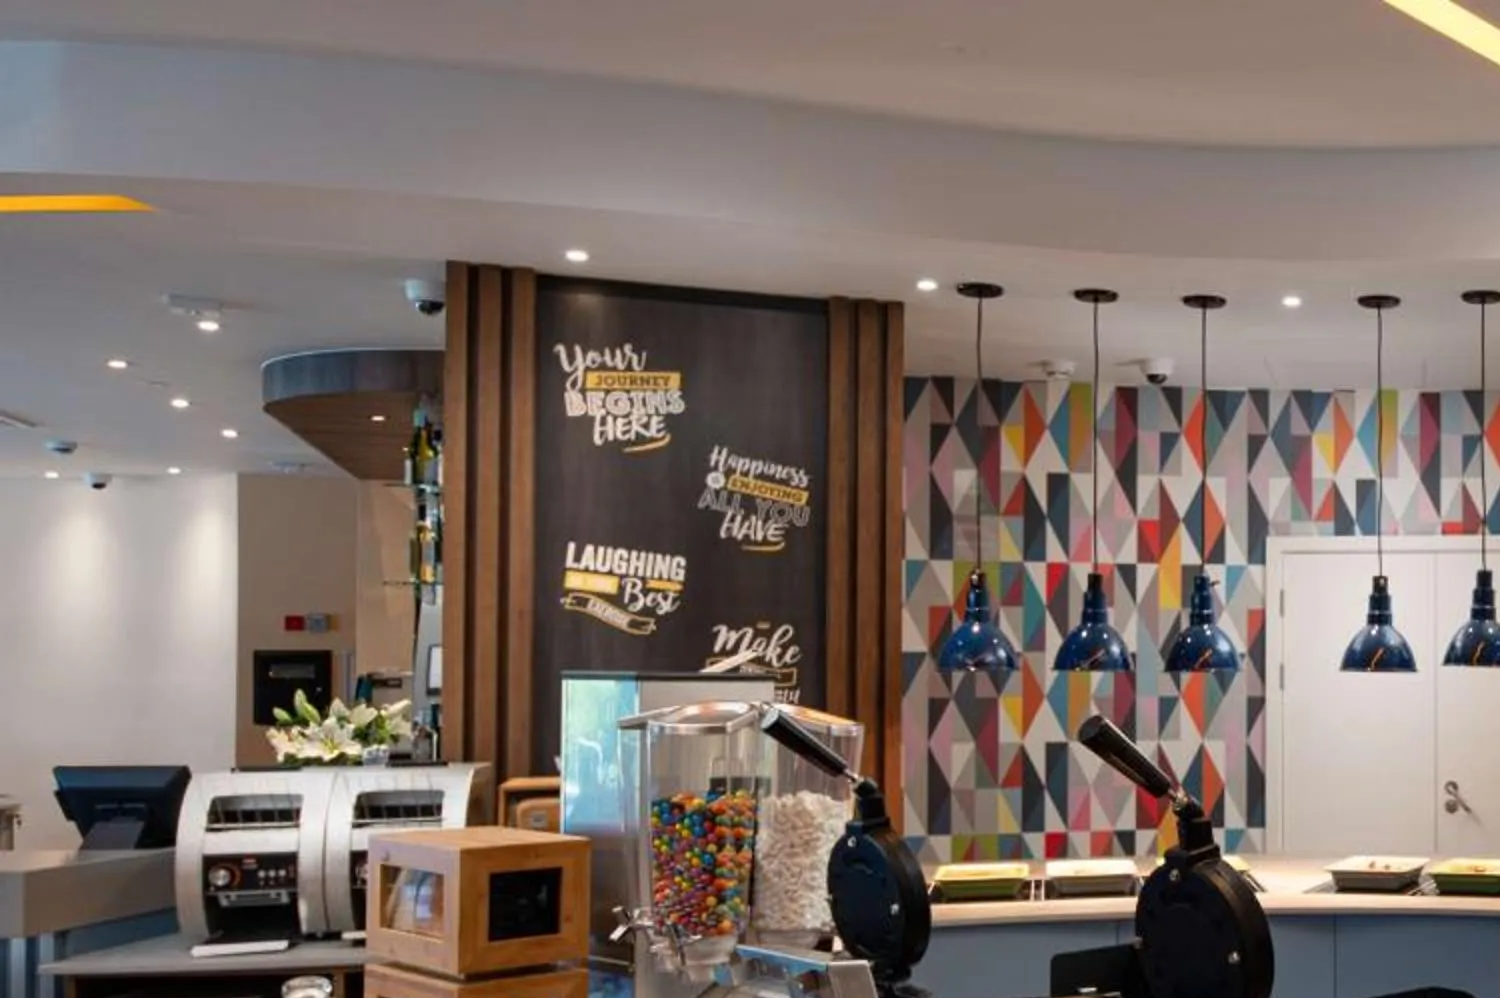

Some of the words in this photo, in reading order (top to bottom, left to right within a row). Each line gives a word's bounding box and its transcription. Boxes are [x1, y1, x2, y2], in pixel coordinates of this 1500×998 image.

[553, 343, 648, 390] Your
[594, 373, 673, 388] JOURNEY
[564, 389, 686, 417] BEGINS
[592, 414, 667, 446] HERE
[709, 444, 811, 488] Happiness
[730, 476, 803, 502] ENJOYING
[719, 508, 789, 543] HAVE
[756, 498, 811, 527] YOU
[565, 541, 687, 581] LAUGHING
[621, 577, 681, 615] Best
[711, 623, 802, 667] Make
